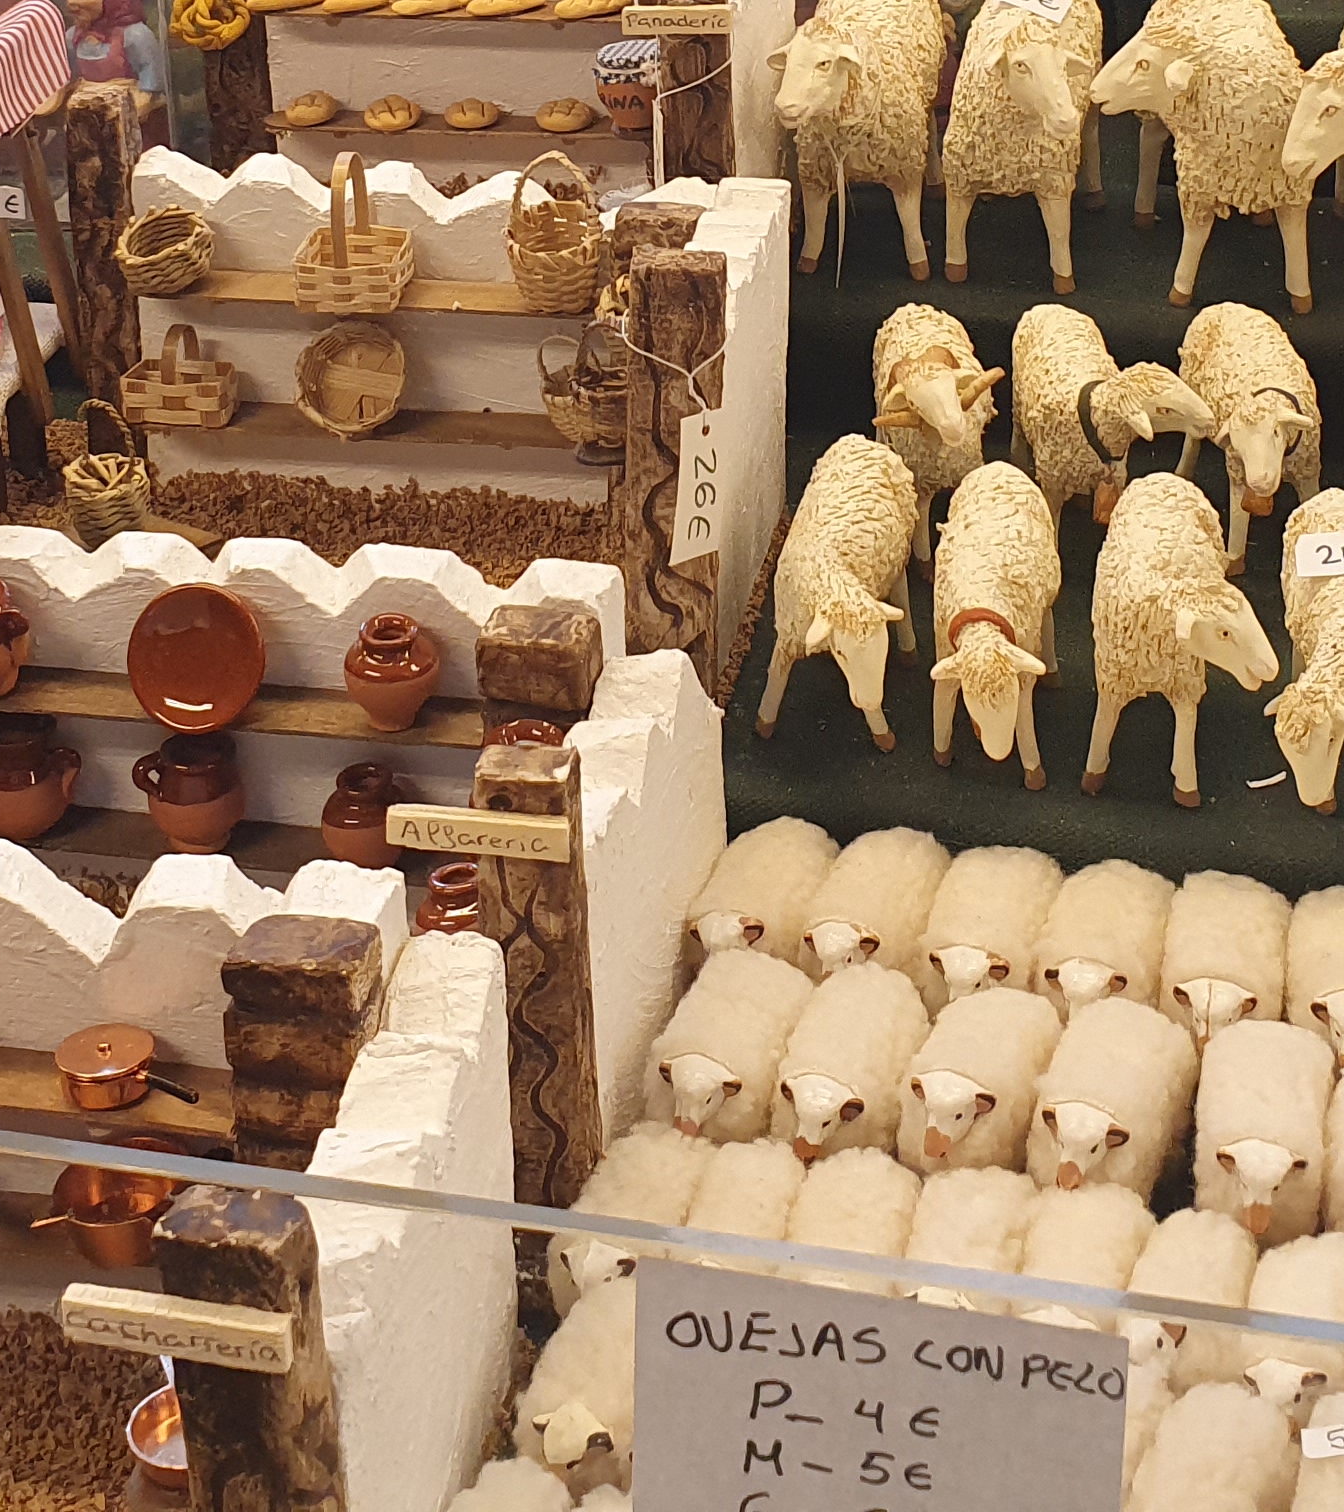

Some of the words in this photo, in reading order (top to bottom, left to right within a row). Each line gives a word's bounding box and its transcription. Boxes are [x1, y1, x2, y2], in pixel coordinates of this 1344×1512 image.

[687, 447, 718, 540] 26€
[665, 1309, 887, 1365] OVEJAS
[912, 1339, 1005, 1381] CON
[1021, 1352, 1126, 1402] PELO
